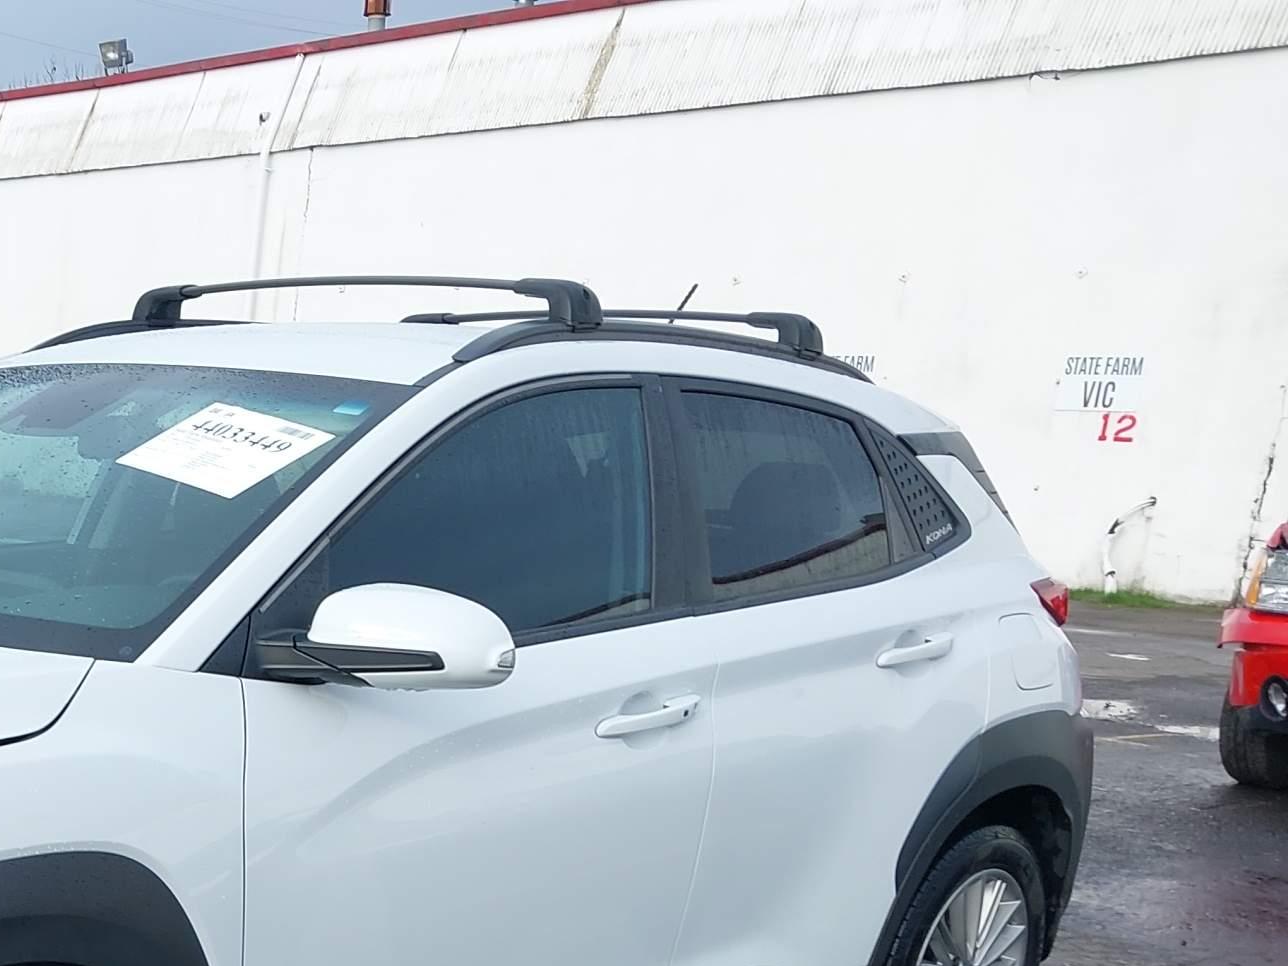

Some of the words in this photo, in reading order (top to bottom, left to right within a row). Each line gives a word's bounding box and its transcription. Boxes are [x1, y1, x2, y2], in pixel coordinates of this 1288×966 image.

[1065, 356, 1103, 376] STATE
[1104, 356, 1144, 376] FARM
[1083, 380, 1116, 408] VIC
[192, 420, 292, 453] 44033449
[1098, 412, 1137, 442] 12
[925, 522, 953, 545] KONA
